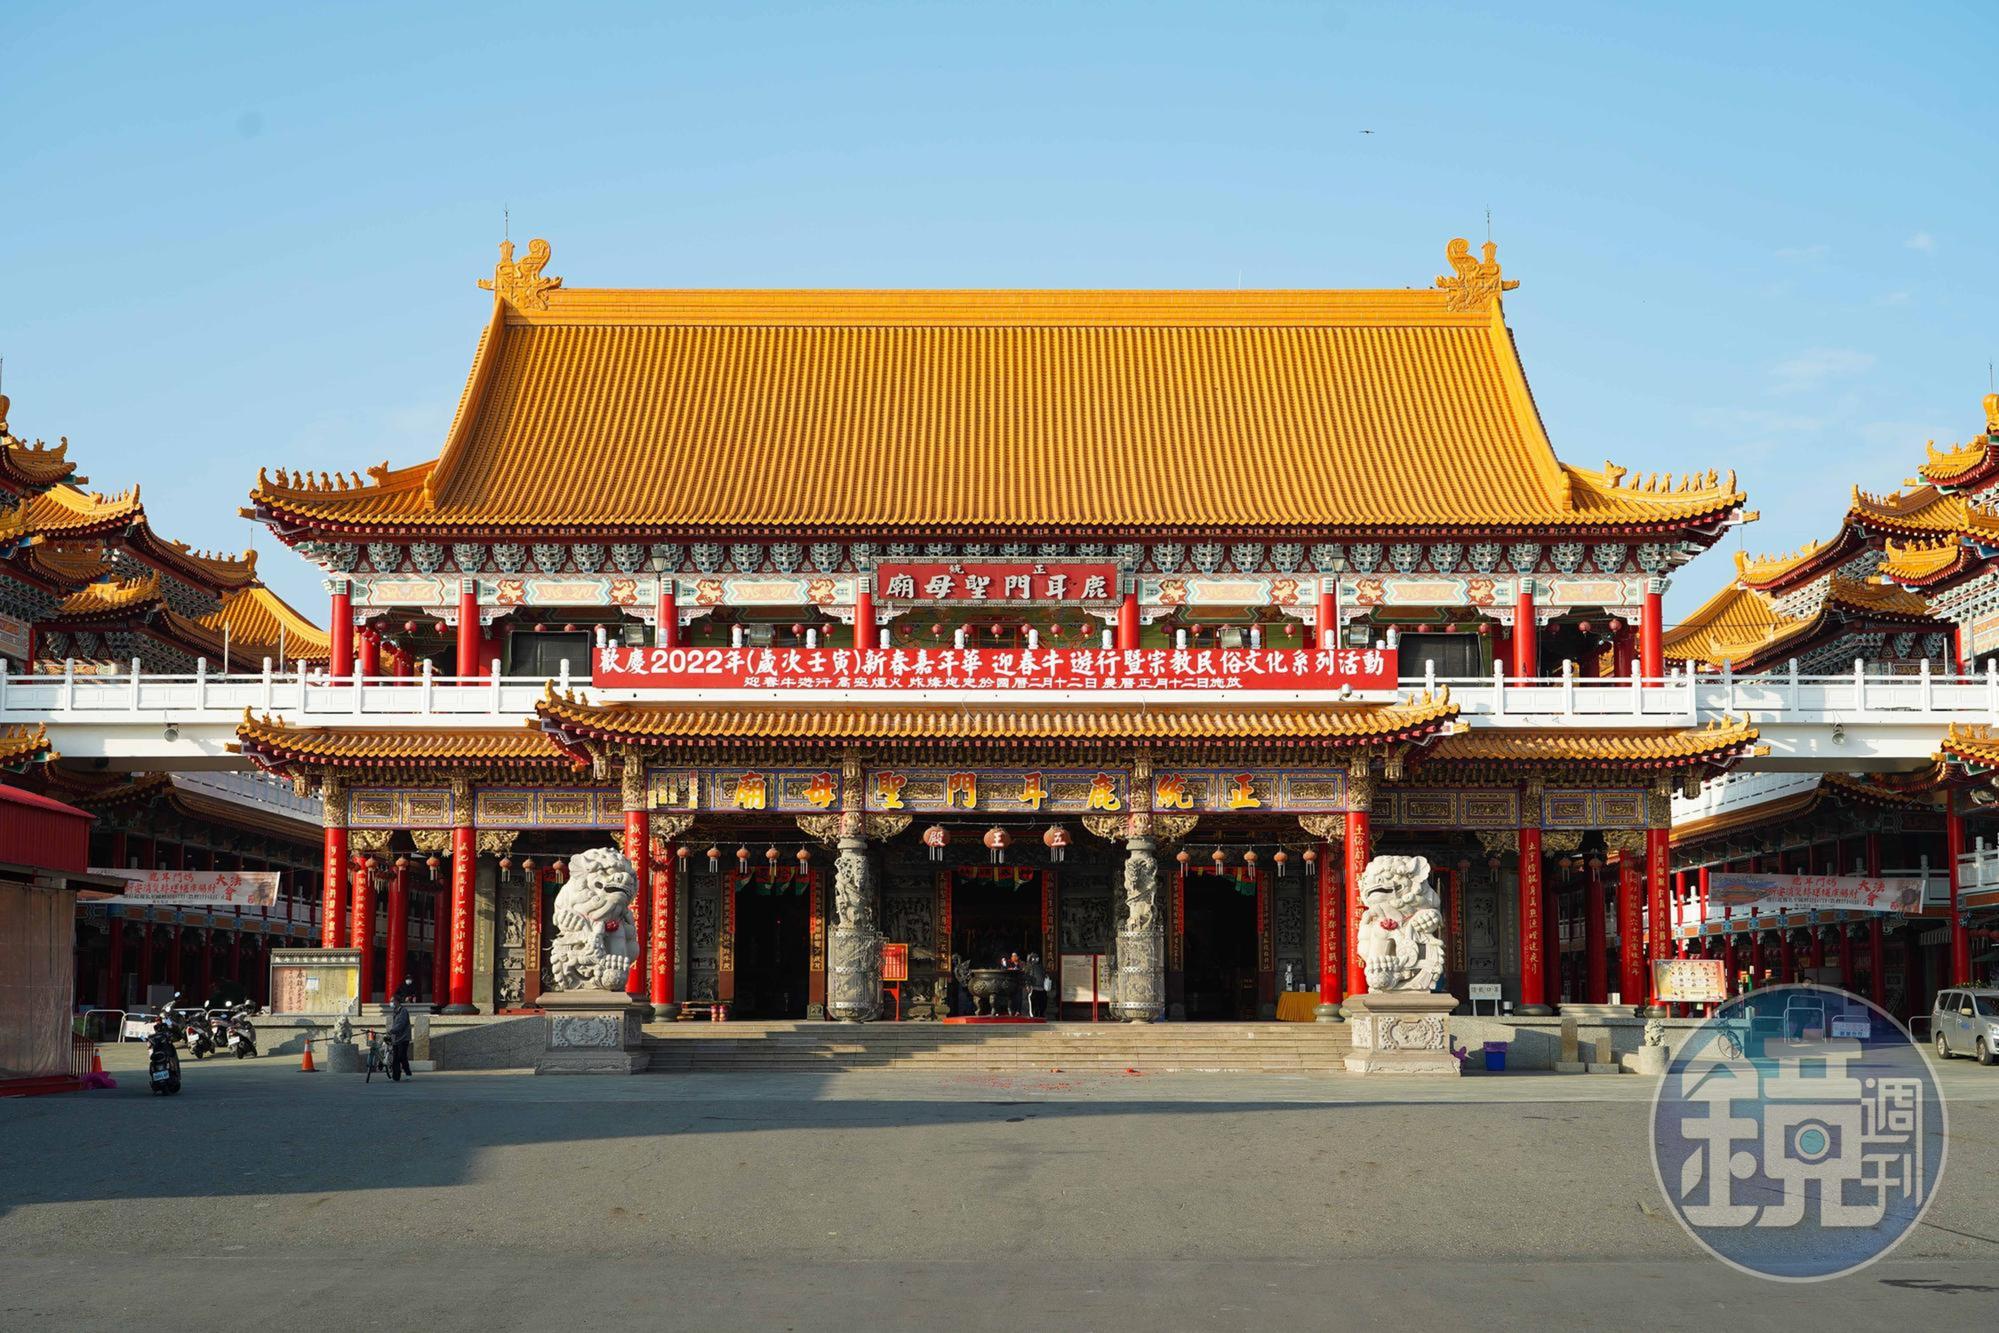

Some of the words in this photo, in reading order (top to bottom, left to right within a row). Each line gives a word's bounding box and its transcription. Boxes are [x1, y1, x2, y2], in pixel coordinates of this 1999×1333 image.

[885, 572, 1108, 600] 鹿耳門聖母廟
